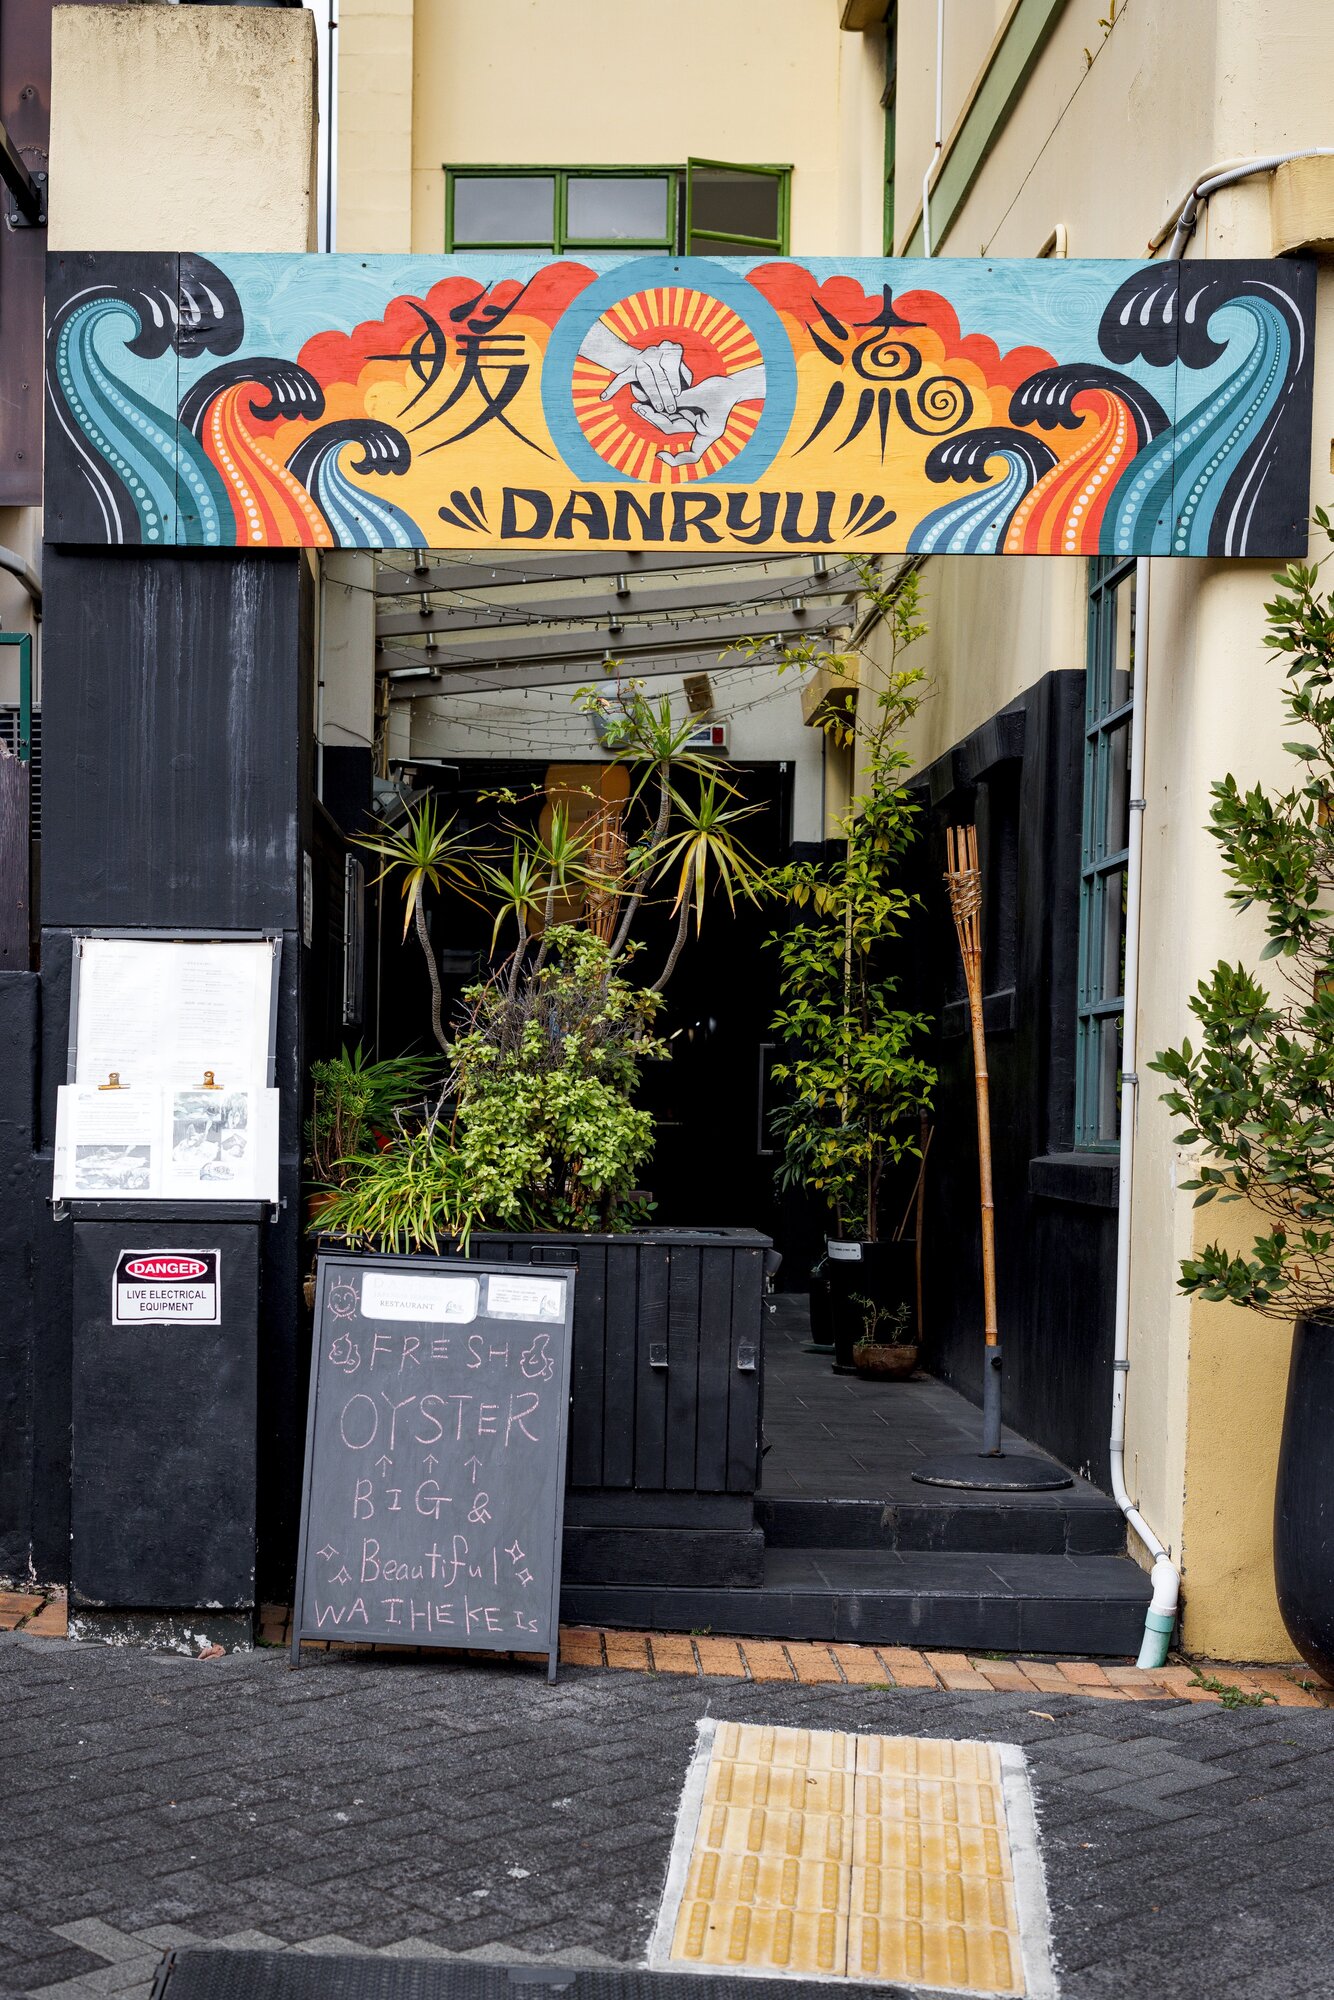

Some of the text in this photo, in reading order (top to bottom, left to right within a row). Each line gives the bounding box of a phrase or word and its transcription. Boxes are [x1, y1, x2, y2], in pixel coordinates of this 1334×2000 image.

[501, 487, 837, 545] DANRYU
[134, 1262, 201, 1274] DANGER
[126, 1290, 207, 1299] LIVE ELECTRICAL
[139, 1302, 194, 1311] EQUIPMENT
[379, 1299, 435, 1311] RESTAURANT
[369, 1332, 509, 1375] FRESH
[340, 1391, 540, 1451] OYSTER
[352, 1477, 492, 1524] BIG &
[360, 1534, 498, 1588] Beautiful
[314, 1595, 504, 1636] WAIHEKE
